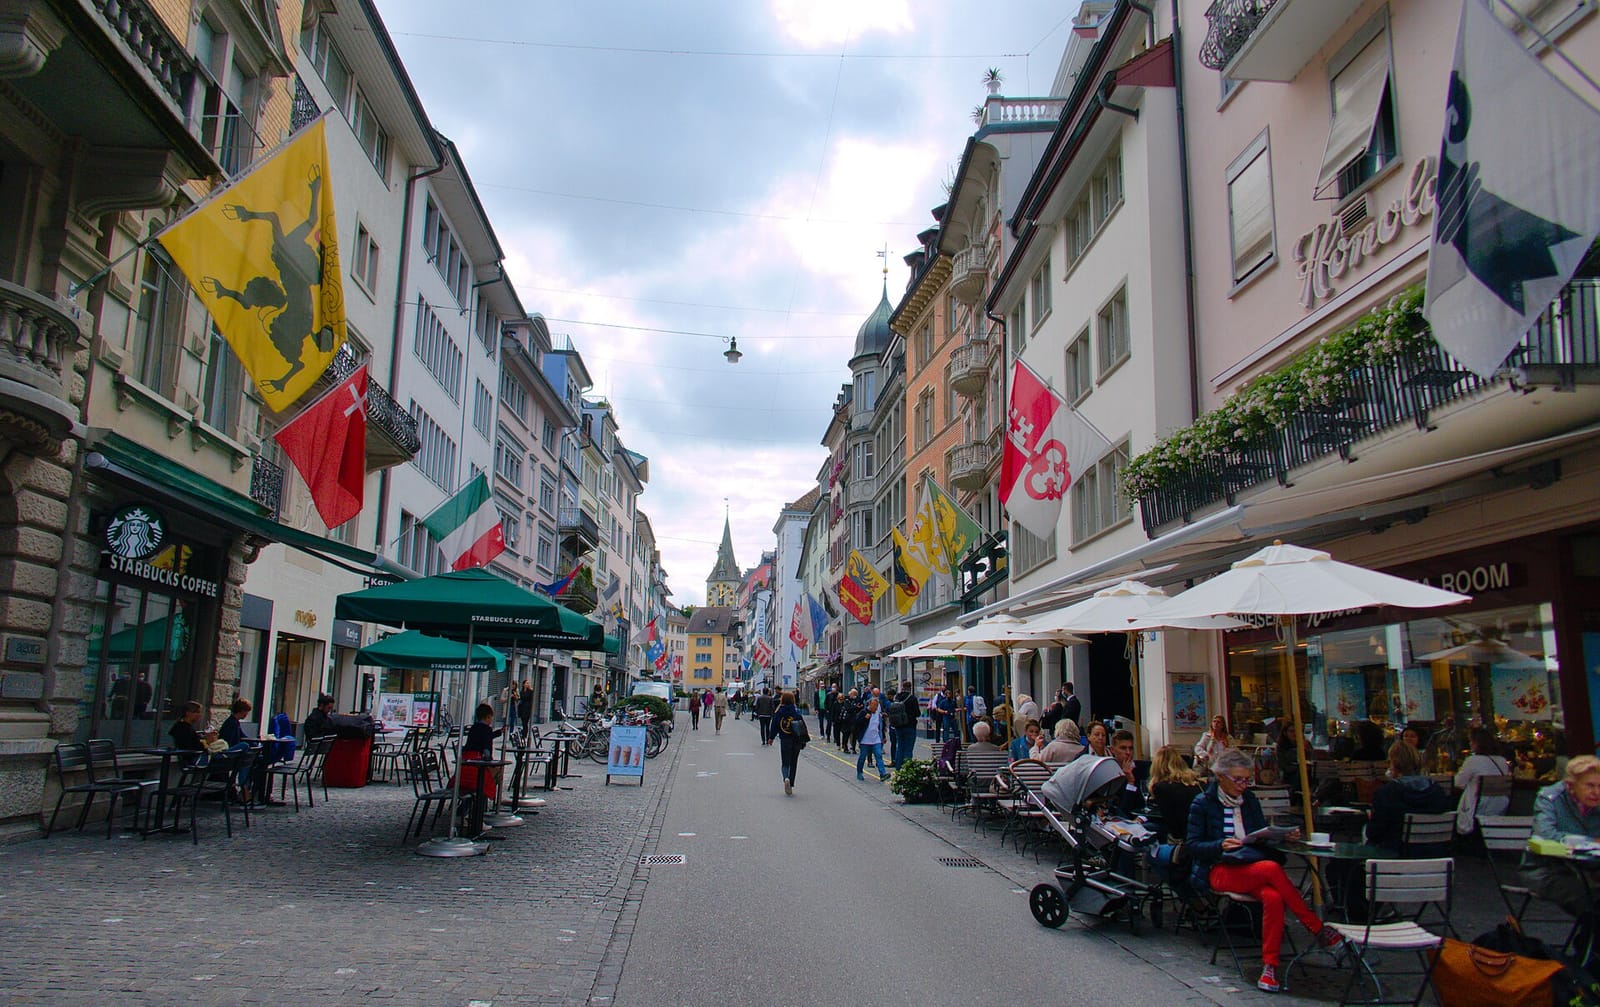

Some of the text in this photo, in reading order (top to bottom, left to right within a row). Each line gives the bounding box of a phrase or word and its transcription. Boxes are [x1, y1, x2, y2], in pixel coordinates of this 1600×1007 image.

[110, 554, 217, 597] STARBUCKS COFFEE
[1442, 563, 1509, 593] ROOM
[471, 615, 540, 625] STARBUCKS COFFEE
